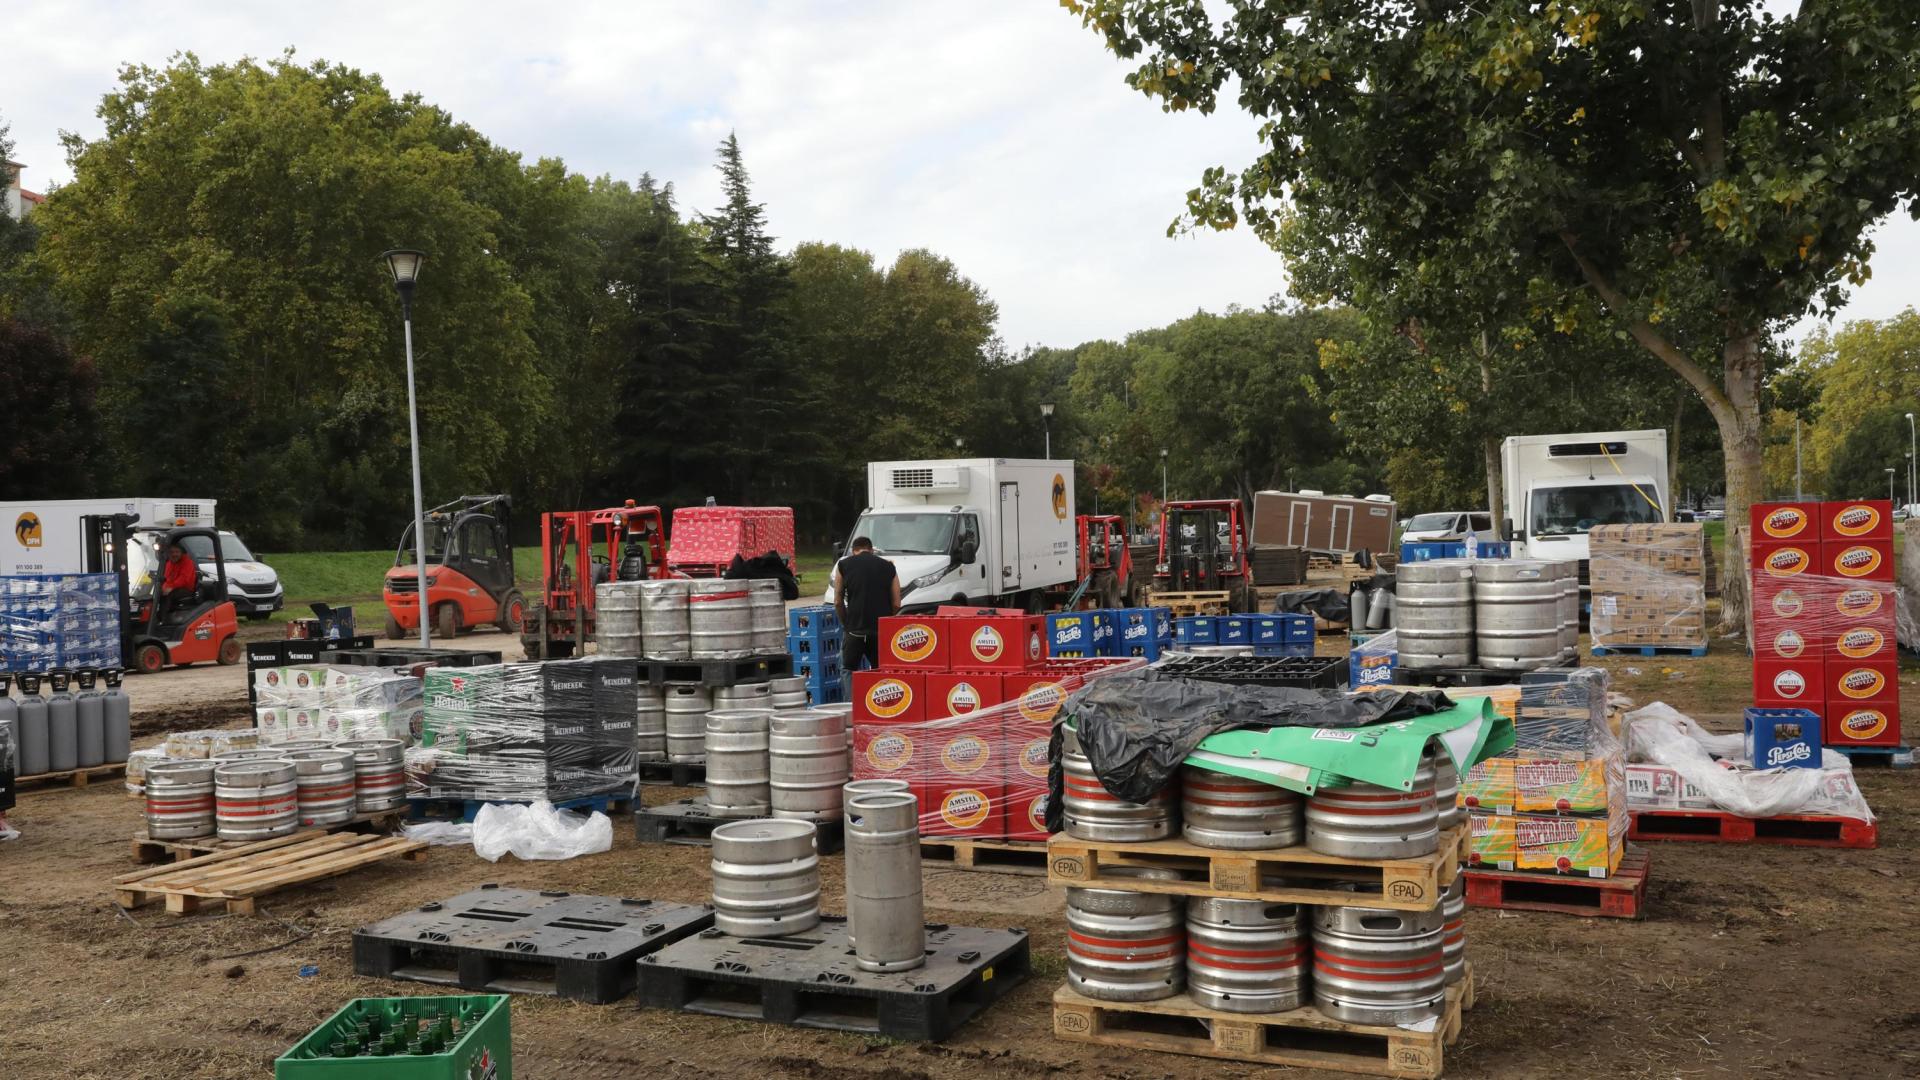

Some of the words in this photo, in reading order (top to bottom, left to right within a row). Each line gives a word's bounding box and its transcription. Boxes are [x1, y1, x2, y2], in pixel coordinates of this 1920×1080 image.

[1771, 512, 1795, 522] AMSTEL
[1843, 508, 1868, 520] AMSTEL
[1772, 553, 1797, 562] AMSTEL
[1843, 552, 1869, 561] AMSTEL
[1844, 556, 1870, 566] CERVEZA
[899, 630, 925, 642] AMSTEL
[1845, 632, 1873, 642] AMSTEL
[900, 637, 927, 649] CERVEZA
[604, 678, 632, 686] HEINEKEN
[1847, 674, 1873, 683] AMSTEL
[1848, 678, 1875, 688] CERVEZA
[553, 682, 583, 690] HEINEKEN
[874, 686, 901, 697] AMSTEL
[875, 692, 903, 704] CERVEZA
[1026, 688, 1056, 701] AMSTEL
[434, 696, 470, 710] Heinek
[1848, 714, 1875, 723] AMSTEL
[1850, 719, 1877, 729] CERVEZA
[554, 726, 584, 736] HEINEKEN
[604, 721, 631, 730] HEINEKEN
[950, 742, 977, 753] AMSTEL
[1028, 744, 1049, 756] AMST
[604, 765, 632, 775] HEINEKEN
[1517, 764, 1578, 786] DESPERADOS
[1629, 780, 1648, 792] IPA
[949, 795, 977, 807] AMSTEL
[1518, 822, 1578, 845] DESPERADOS
[1058, 862, 1079, 873] EPAL
[1393, 885, 1419, 898] EPAL
[1063, 1017, 1084, 1029] EPAL
[1400, 1052, 1424, 1066] EPAL
